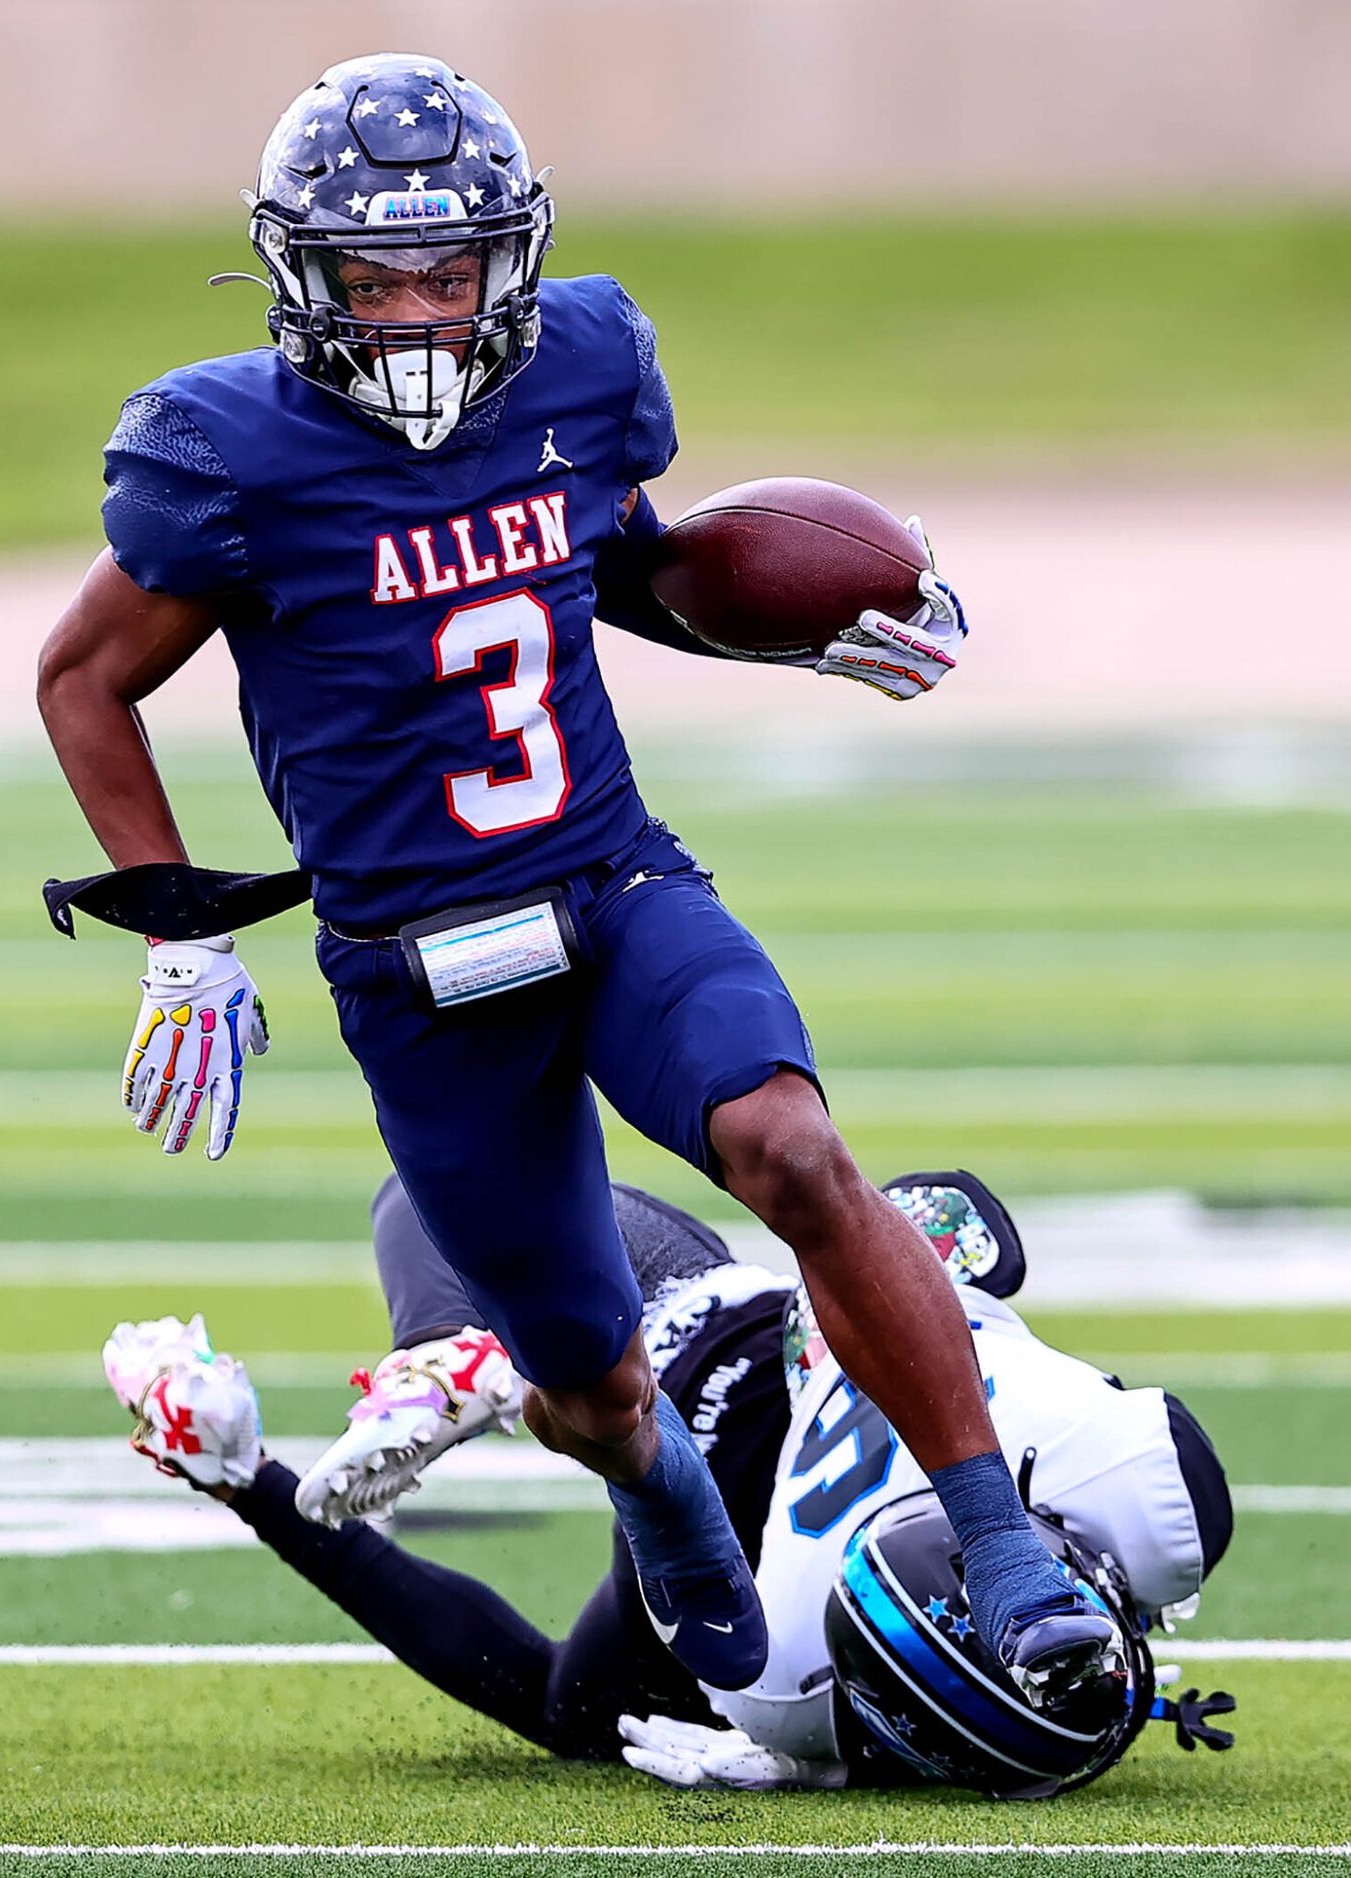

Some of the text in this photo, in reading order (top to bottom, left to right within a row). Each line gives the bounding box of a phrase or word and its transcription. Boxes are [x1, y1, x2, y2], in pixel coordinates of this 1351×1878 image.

[384, 195, 449, 219] ALLEN
[370, 491, 572, 604] ALLEN
[431, 587, 572, 839] 3
